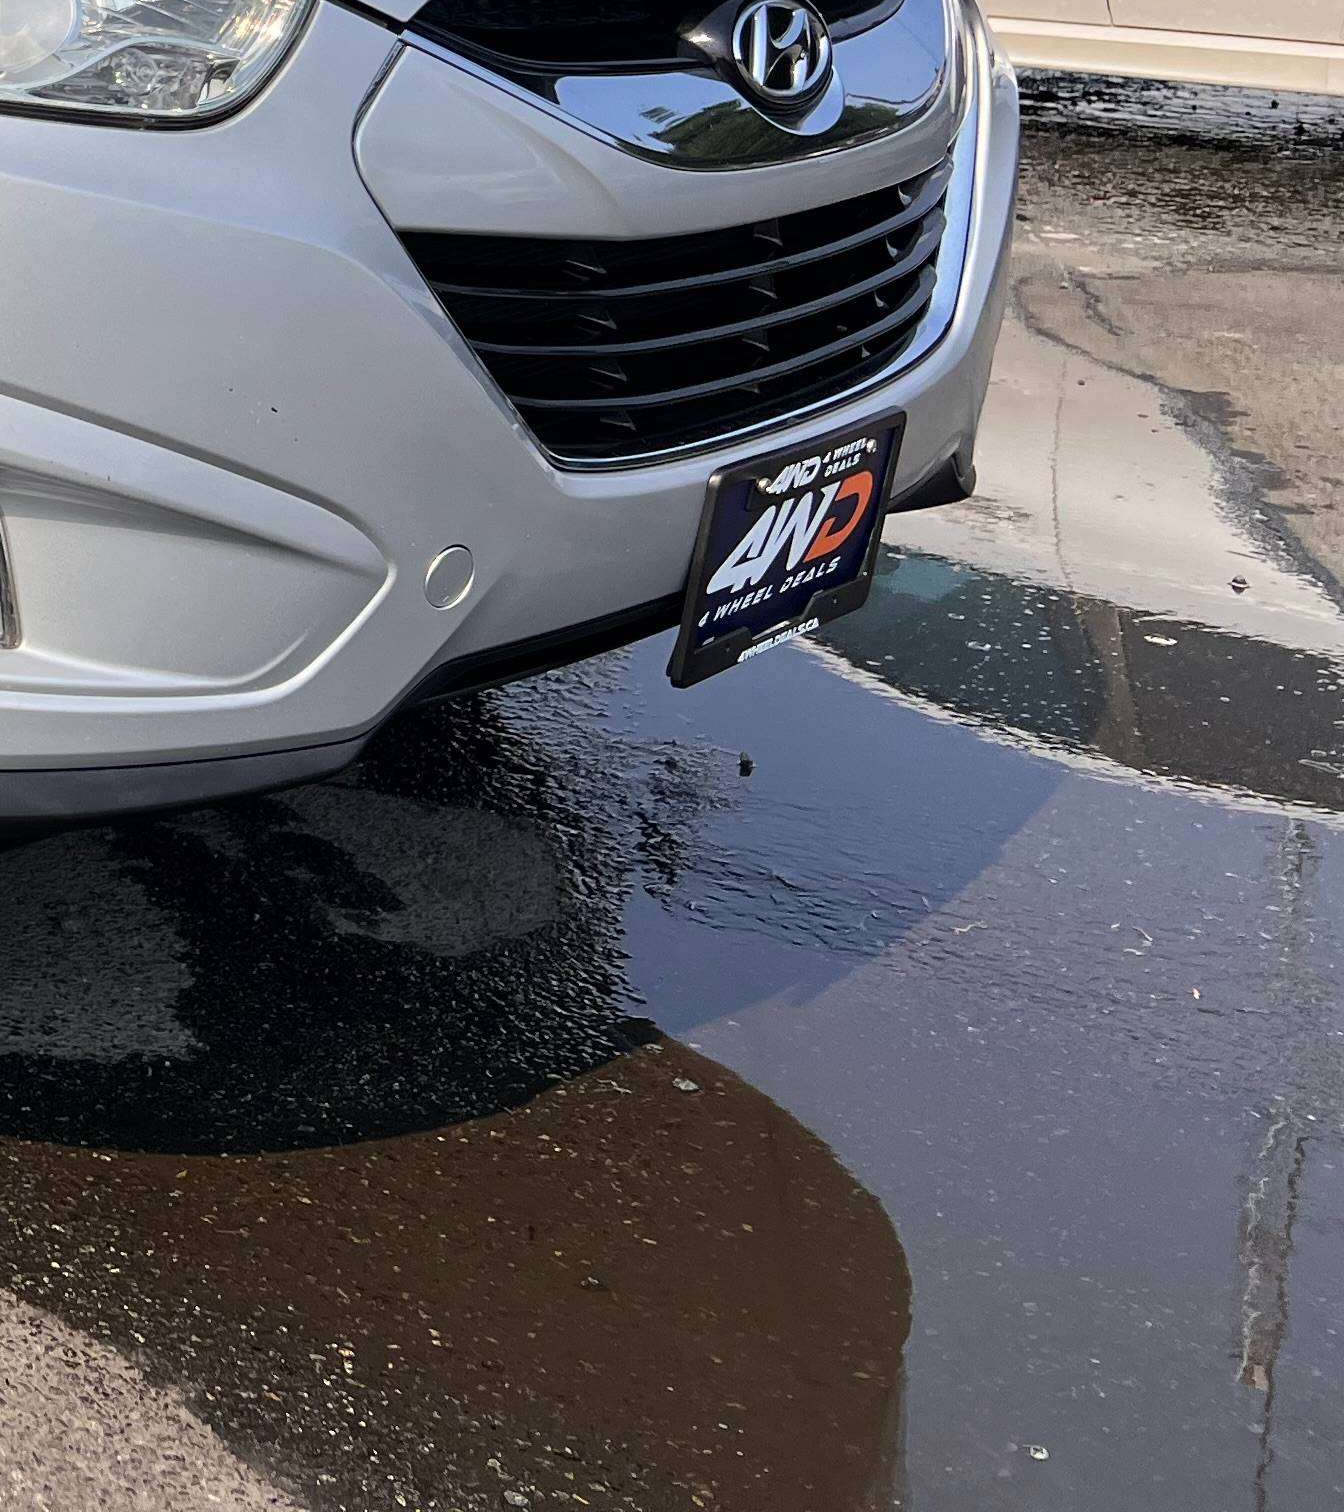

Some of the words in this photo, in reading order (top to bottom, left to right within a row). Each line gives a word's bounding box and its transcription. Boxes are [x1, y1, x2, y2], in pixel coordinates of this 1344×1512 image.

[824, 453, 860, 477] DEALS
[832, 437, 867, 460] WHEEL
[707, 471, 873, 594] 4WD
[698, 611, 709, 627] 4
[713, 584, 773, 622] WHEEL
[779, 556, 841, 593] DEALS
